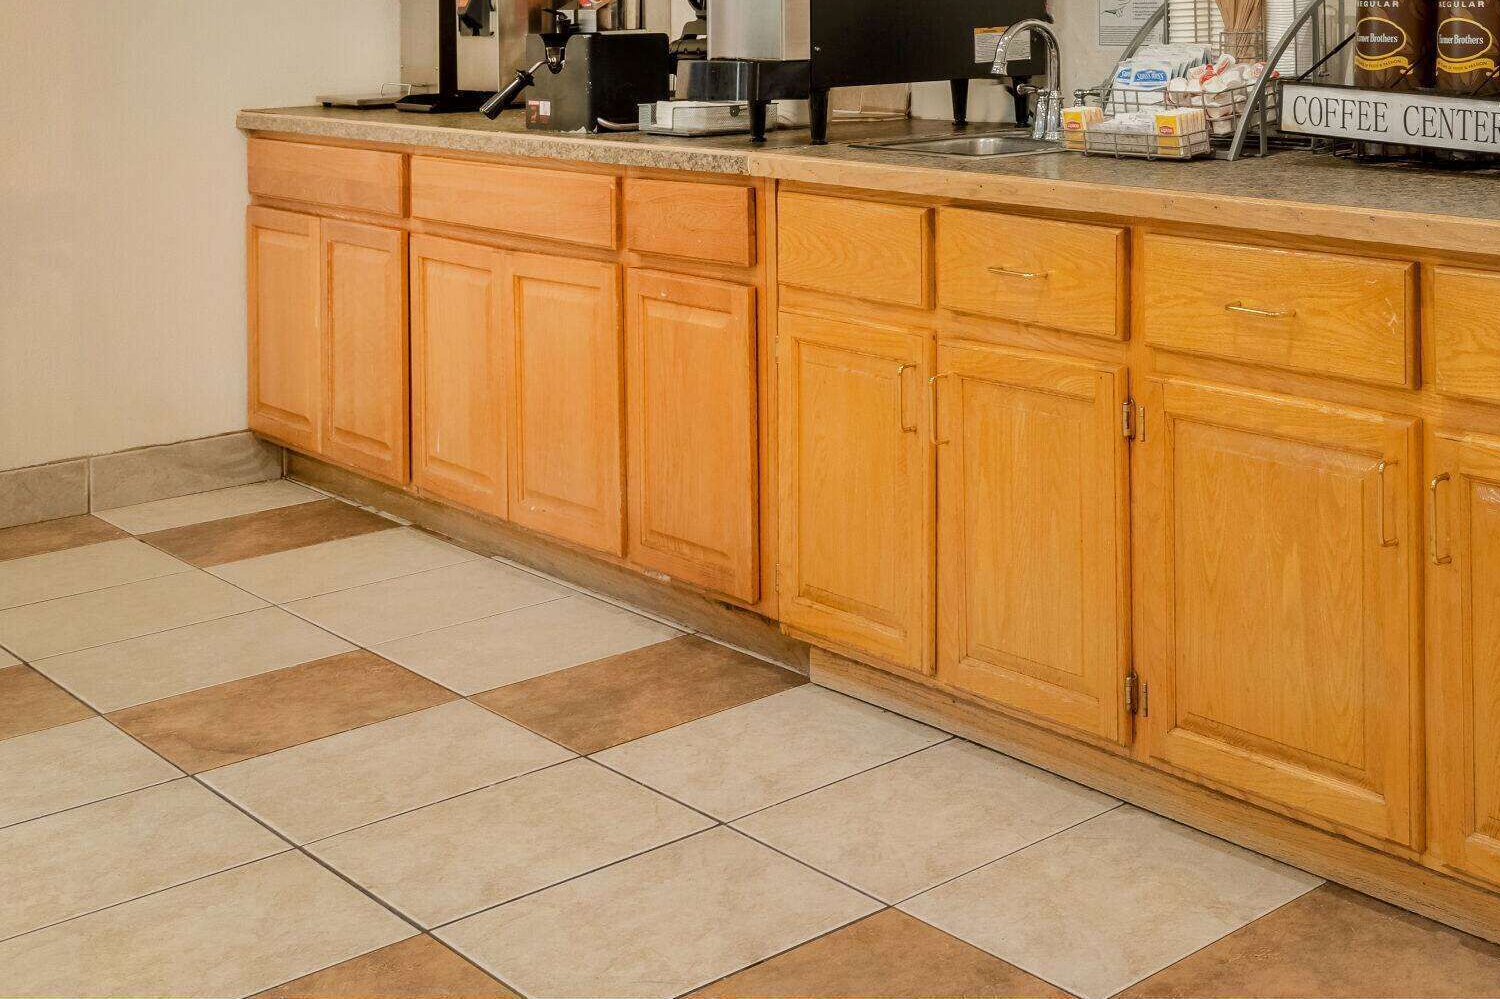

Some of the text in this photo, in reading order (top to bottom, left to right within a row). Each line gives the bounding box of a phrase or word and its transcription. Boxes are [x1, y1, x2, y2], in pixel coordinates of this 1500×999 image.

[1370, 32, 1398, 43] Brothers
[1453, 34, 1484, 45] Brothers
[1293, 95, 1388, 133] COFFEE
